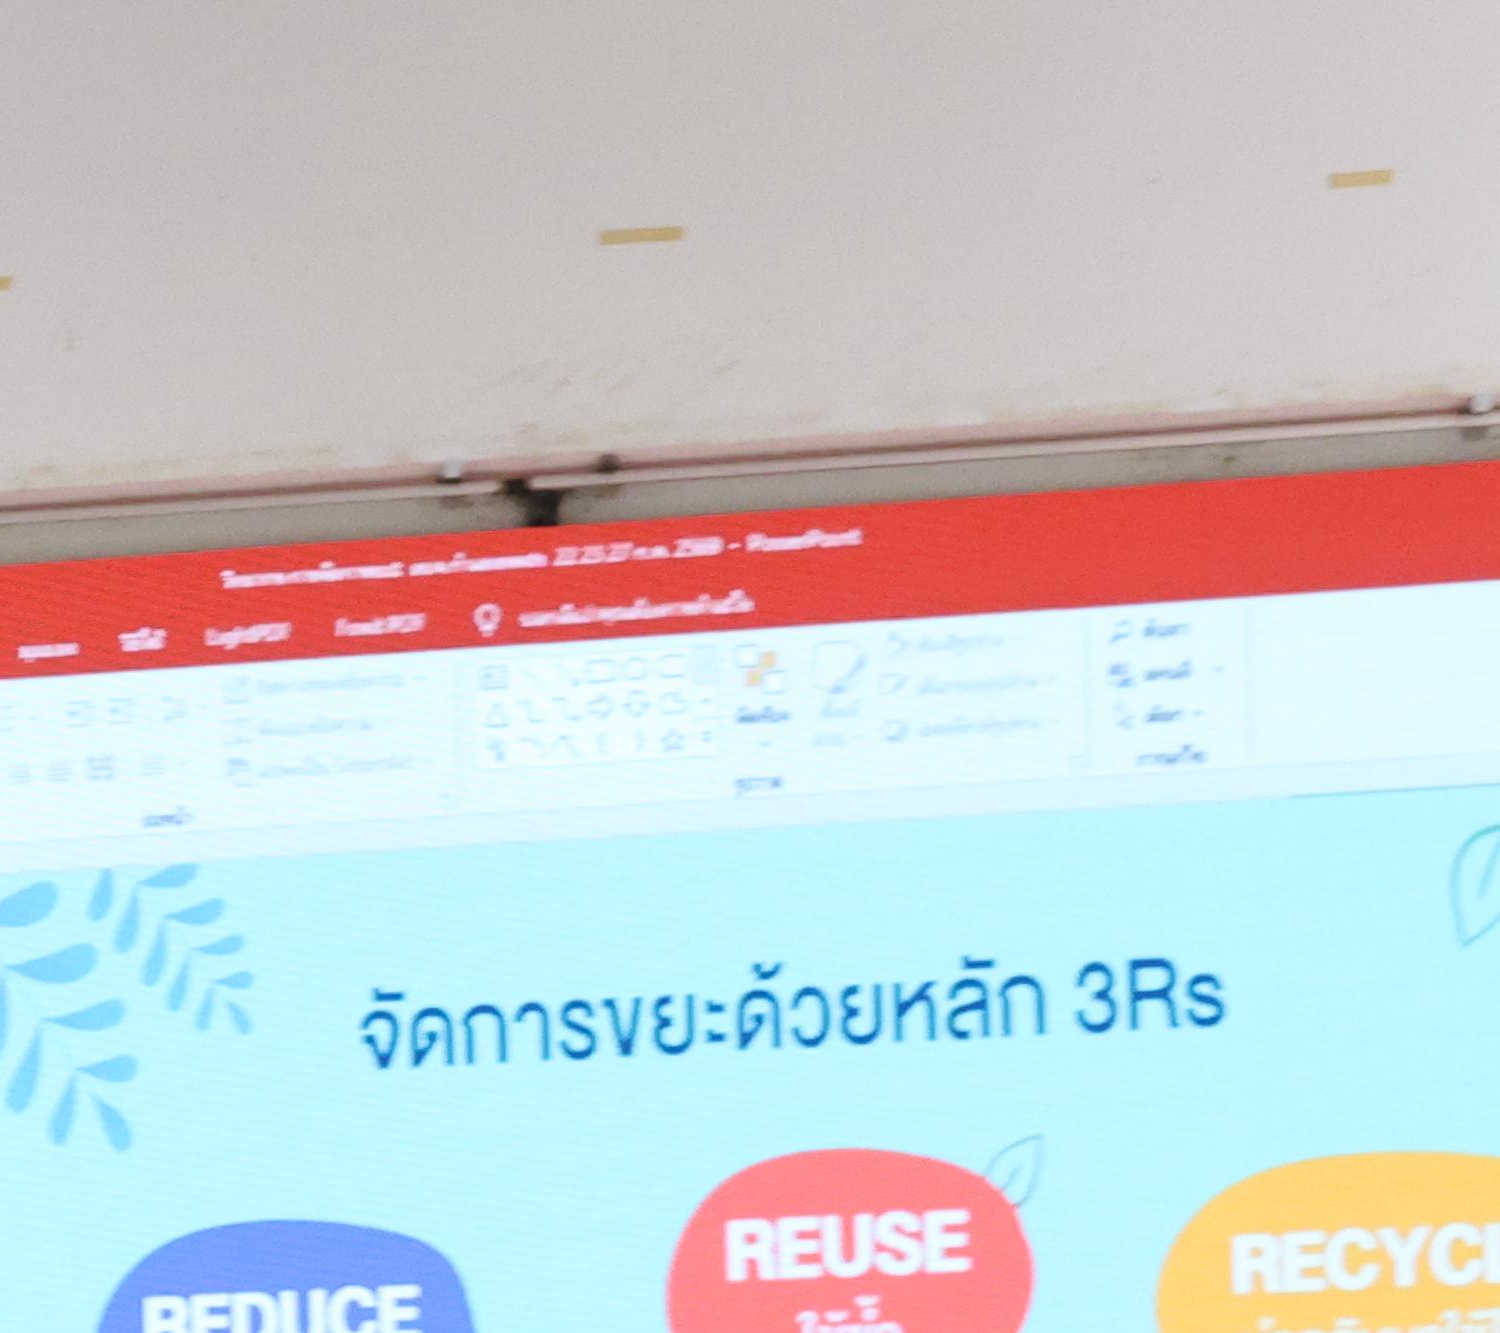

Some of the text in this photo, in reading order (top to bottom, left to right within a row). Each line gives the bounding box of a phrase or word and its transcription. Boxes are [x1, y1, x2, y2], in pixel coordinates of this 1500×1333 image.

[359, 956, 1226, 1069] จัดการขยะด้วยหลัก 3Rs
[723, 1207, 974, 1283] REUSE
[1230, 1221, 1500, 1296] RECYC
